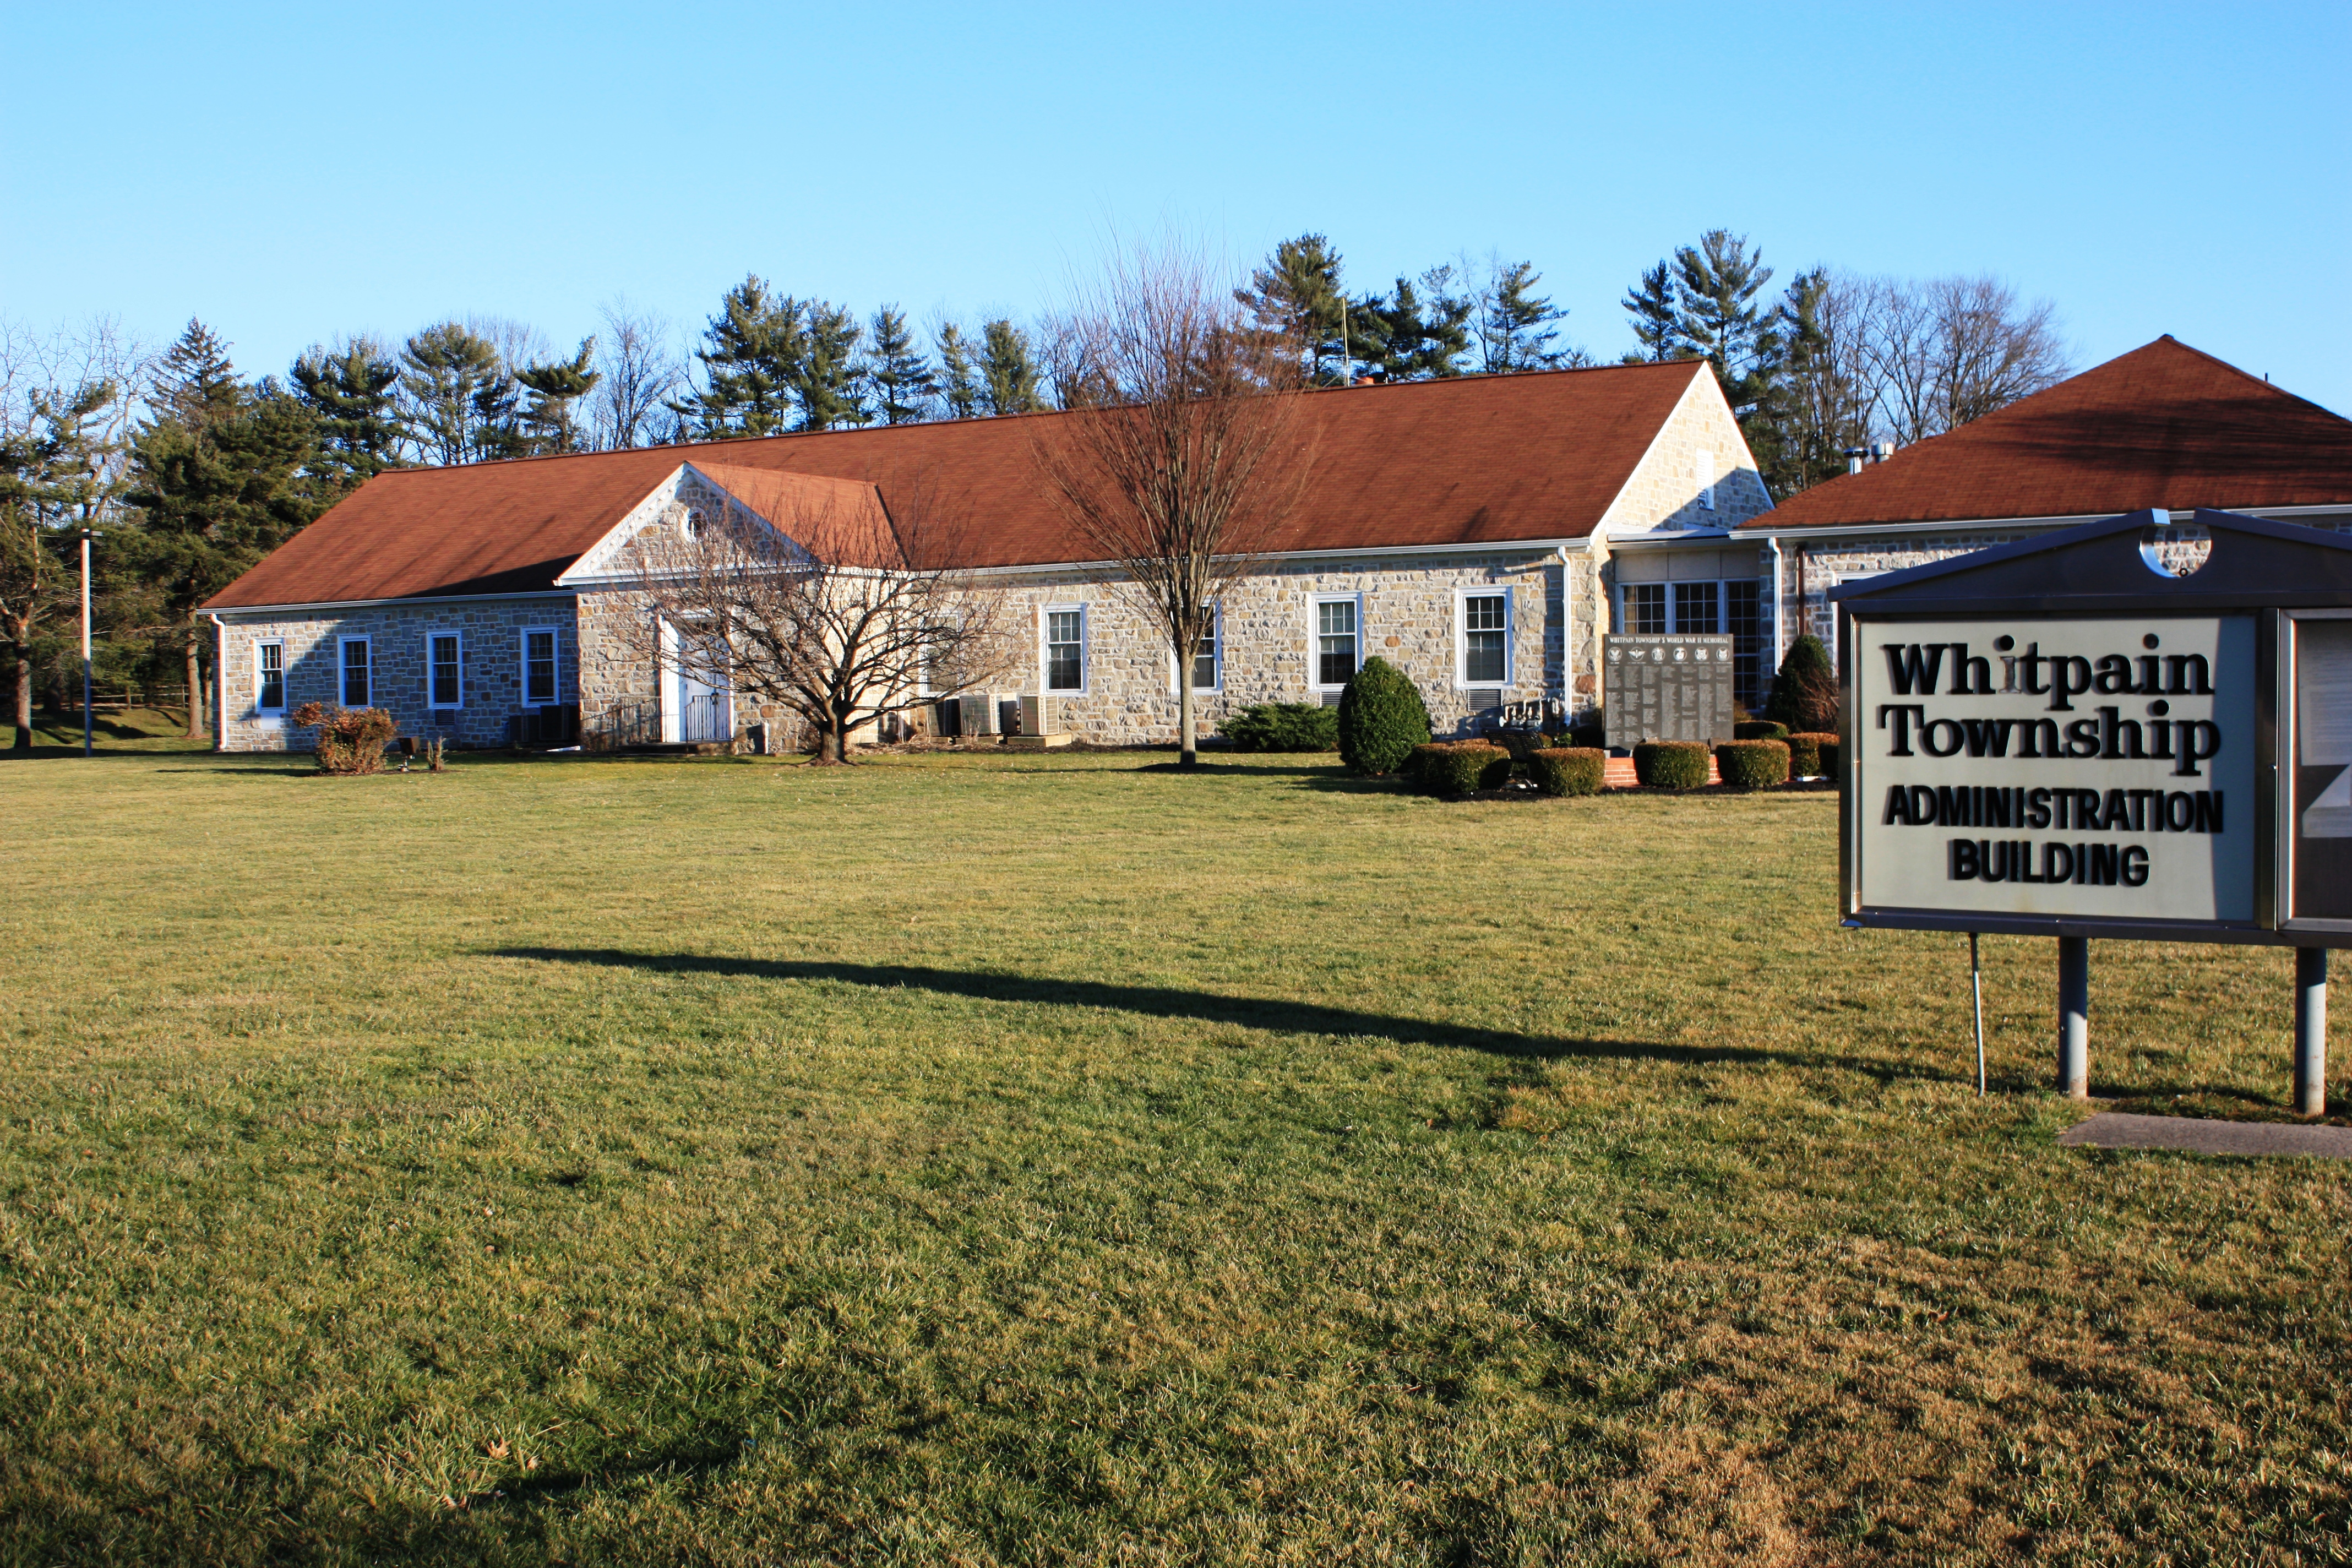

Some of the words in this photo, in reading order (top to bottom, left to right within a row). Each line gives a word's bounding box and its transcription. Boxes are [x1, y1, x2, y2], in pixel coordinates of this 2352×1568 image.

[1882, 634, 2215, 712] Whitpain
[1880, 700, 2222, 776] Township
[1886, 785, 2224, 834] ADMINISTRATION
[1953, 839, 2150, 887] BUILDING
